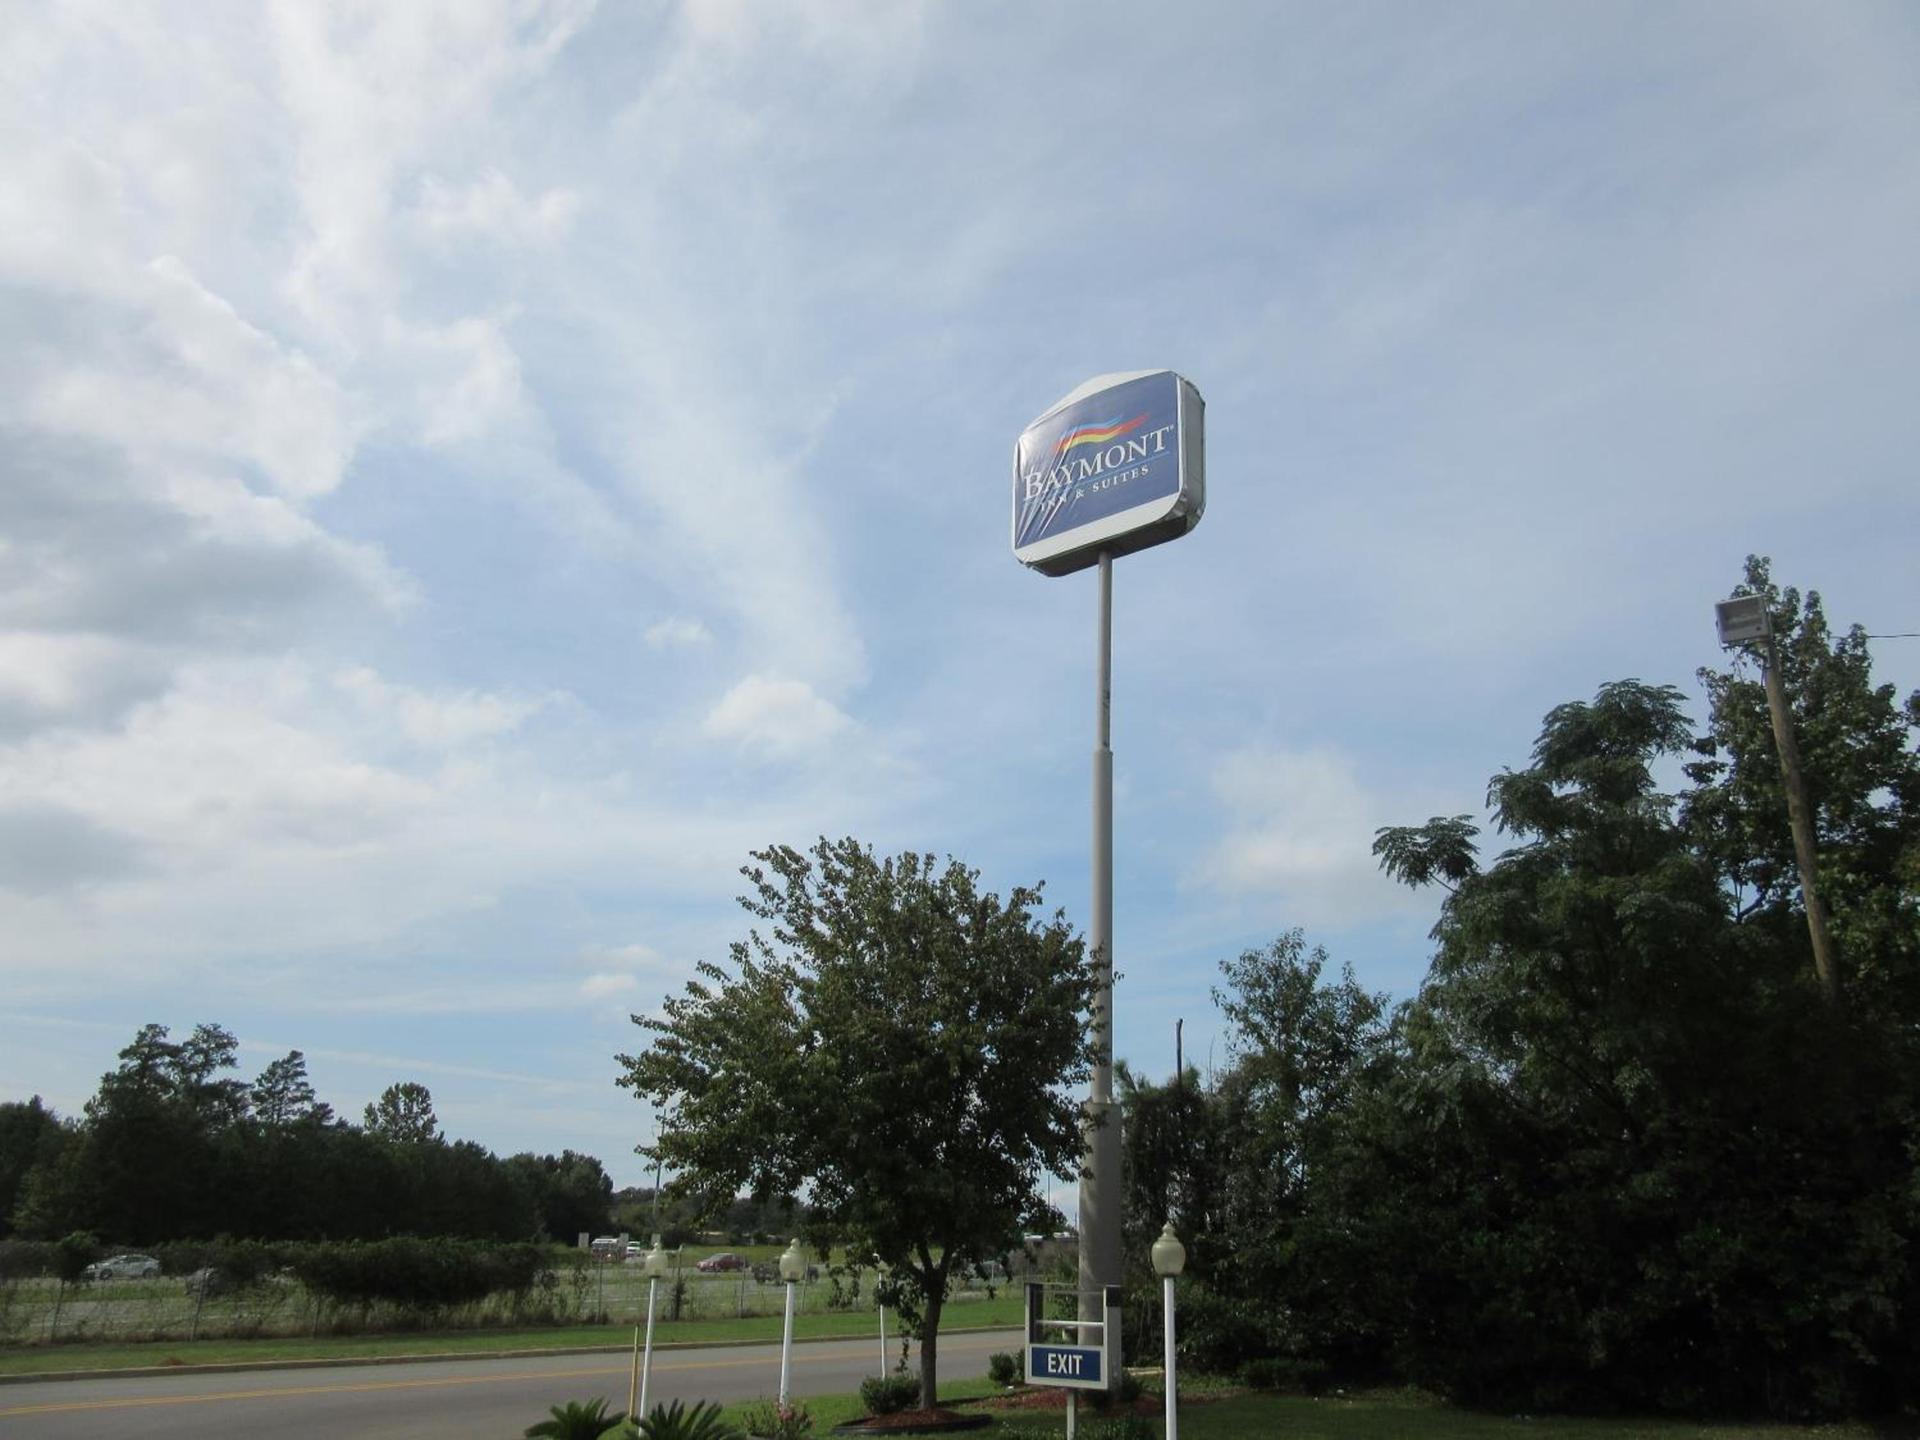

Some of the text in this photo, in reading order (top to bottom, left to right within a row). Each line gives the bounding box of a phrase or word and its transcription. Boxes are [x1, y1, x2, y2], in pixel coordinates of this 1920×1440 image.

[1023, 426, 1170, 501] BAYMONT
[1075, 489, 1085, 500] &
[1092, 464, 1149, 492] SUITES
[1047, 1353, 1083, 1375] EXIT
